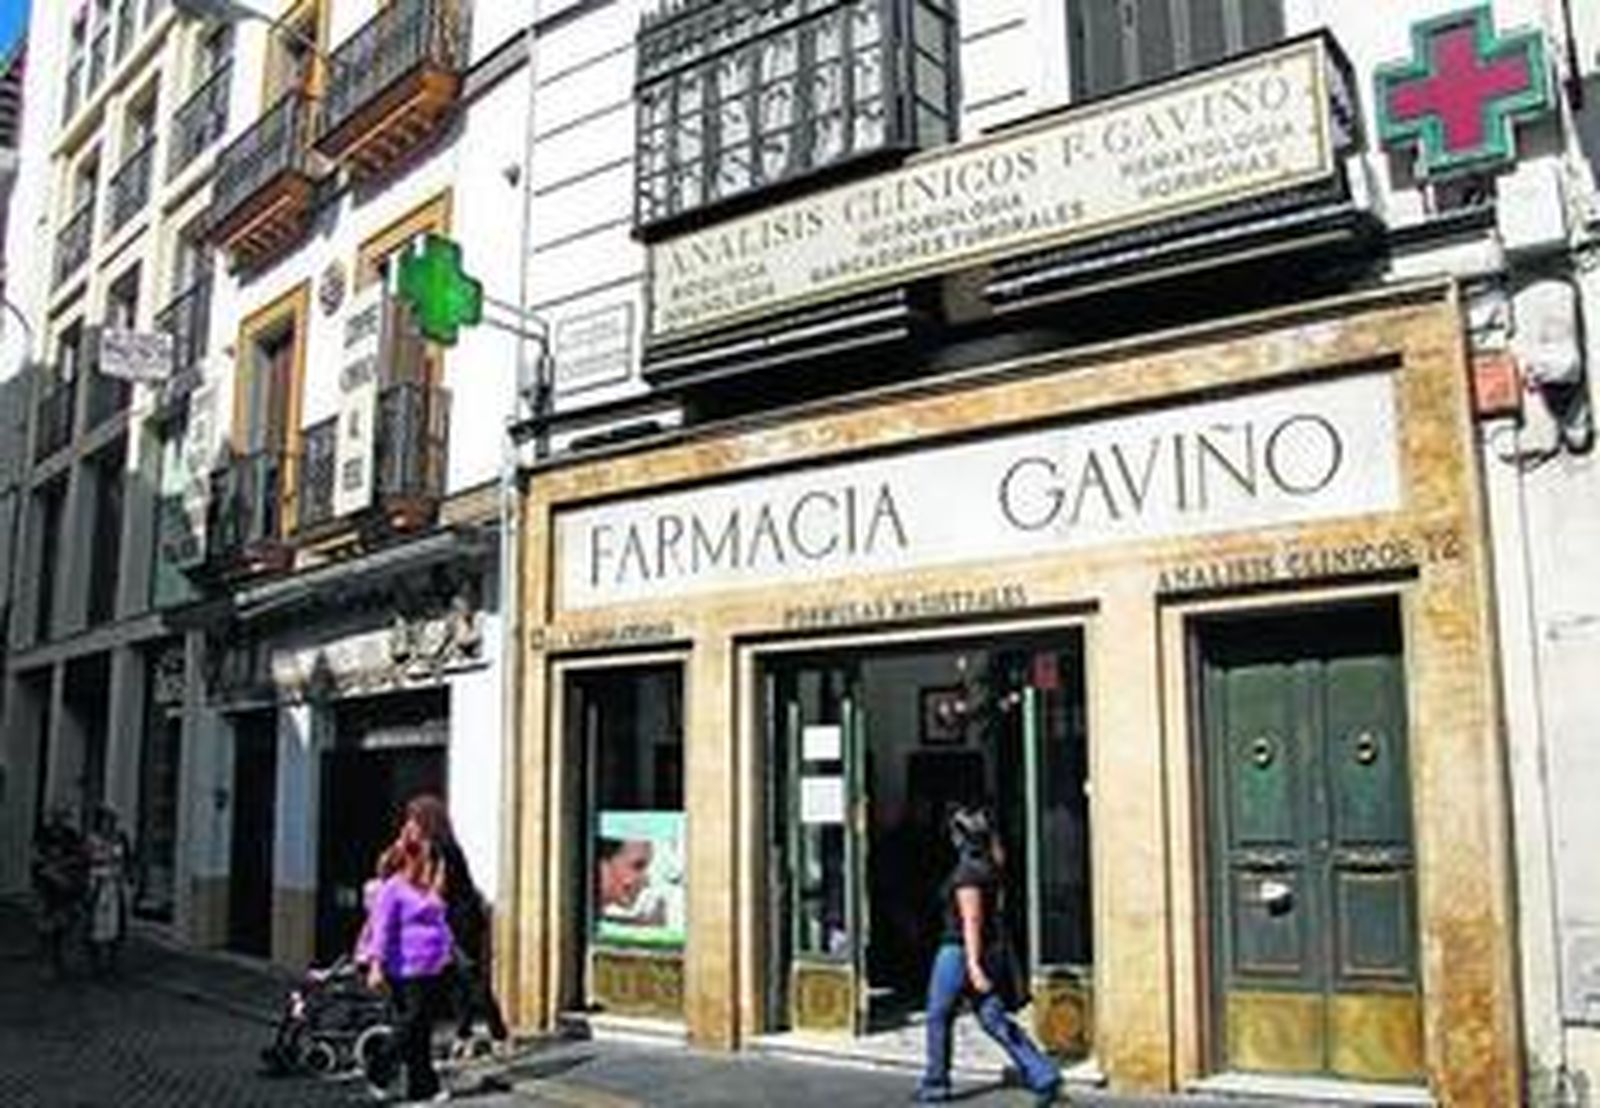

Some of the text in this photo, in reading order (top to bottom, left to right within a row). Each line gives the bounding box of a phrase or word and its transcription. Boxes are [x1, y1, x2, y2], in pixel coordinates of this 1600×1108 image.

[668, 209, 824, 280] ANALISIS
[843, 152, 1038, 225] CLINICOS
[1102, 78, 1291, 154] GAVIÑO
[590, 413, 1344, 589] FARMACIA GAVIÑO
